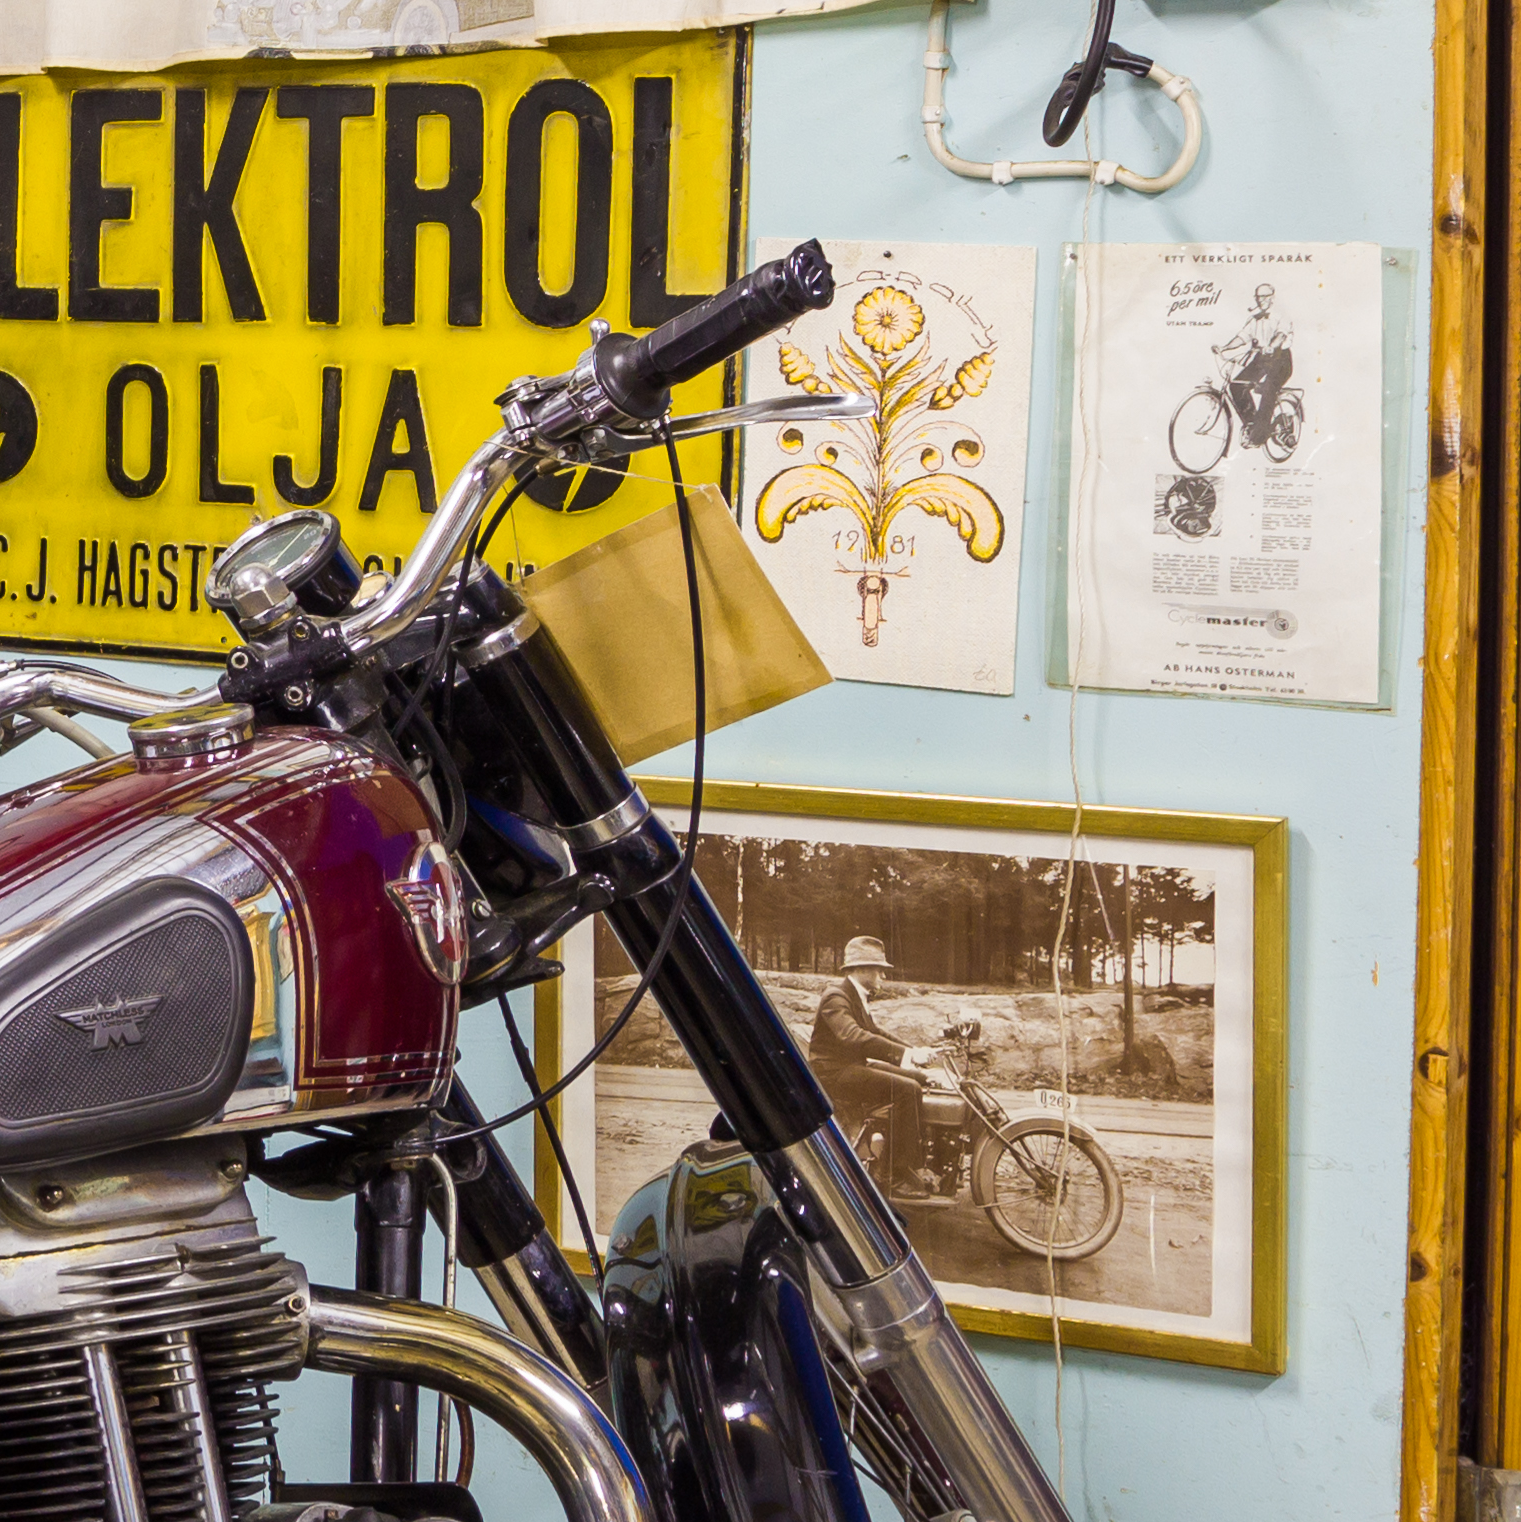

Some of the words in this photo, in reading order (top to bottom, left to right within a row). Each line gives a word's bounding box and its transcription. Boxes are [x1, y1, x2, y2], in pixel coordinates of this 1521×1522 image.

[1165, 255, 1186, 263] ETT
[1192, 254, 1255, 264] VERKLIGT
[1261, 252, 1313, 264] SPARÅK
[1166, 297, 1194, 317] per
[1195, 288, 1223, 306] mil
[106, 362, 438, 514] OLJA
[1168, 608, 1268, 628] Cyclemaster
[1163, 663, 1181, 673] AB
[1185, 664, 1221, 675] HANS
[1225, 667, 1296, 680] OSTERMAN
[82, 1005, 145, 1024] MATCHLESS
